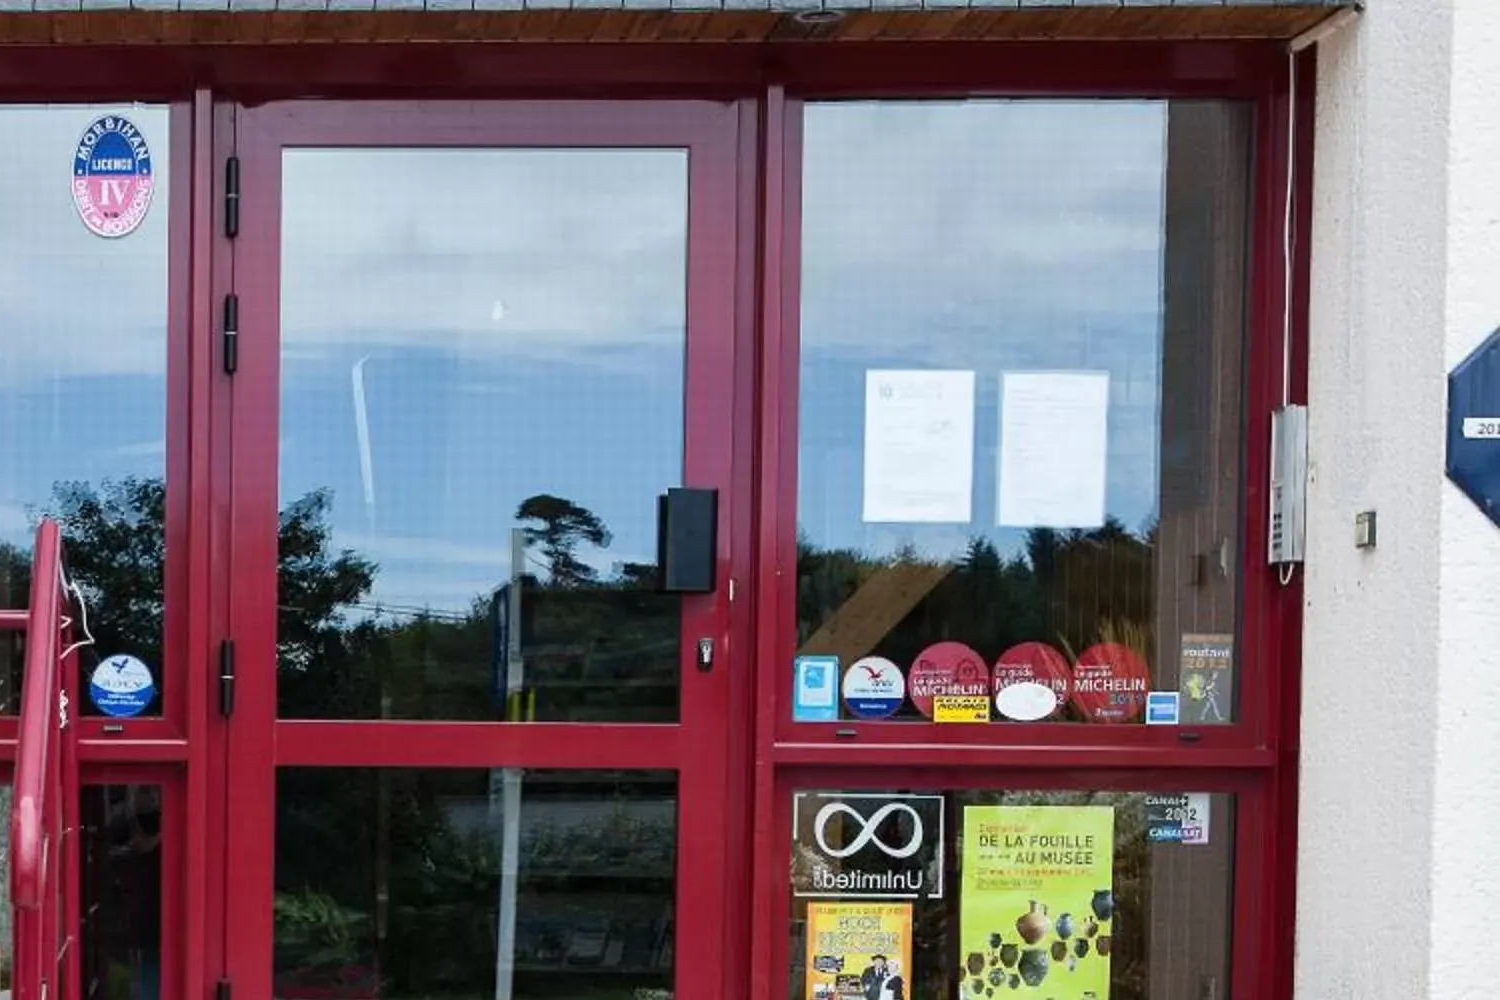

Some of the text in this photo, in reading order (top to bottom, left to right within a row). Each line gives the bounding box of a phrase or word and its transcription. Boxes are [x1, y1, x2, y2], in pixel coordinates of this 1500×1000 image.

[77, 117, 149, 161] MORBIHAN
[99, 179, 131, 206] IV
[913, 682, 984, 697] MICHELIN
[1073, 677, 1146, 693] MICHELIN
[1164, 807, 1198, 821] 2012
[979, 835, 1094, 849] DE LA FOUILLE
[1015, 851, 1035, 864] AU
